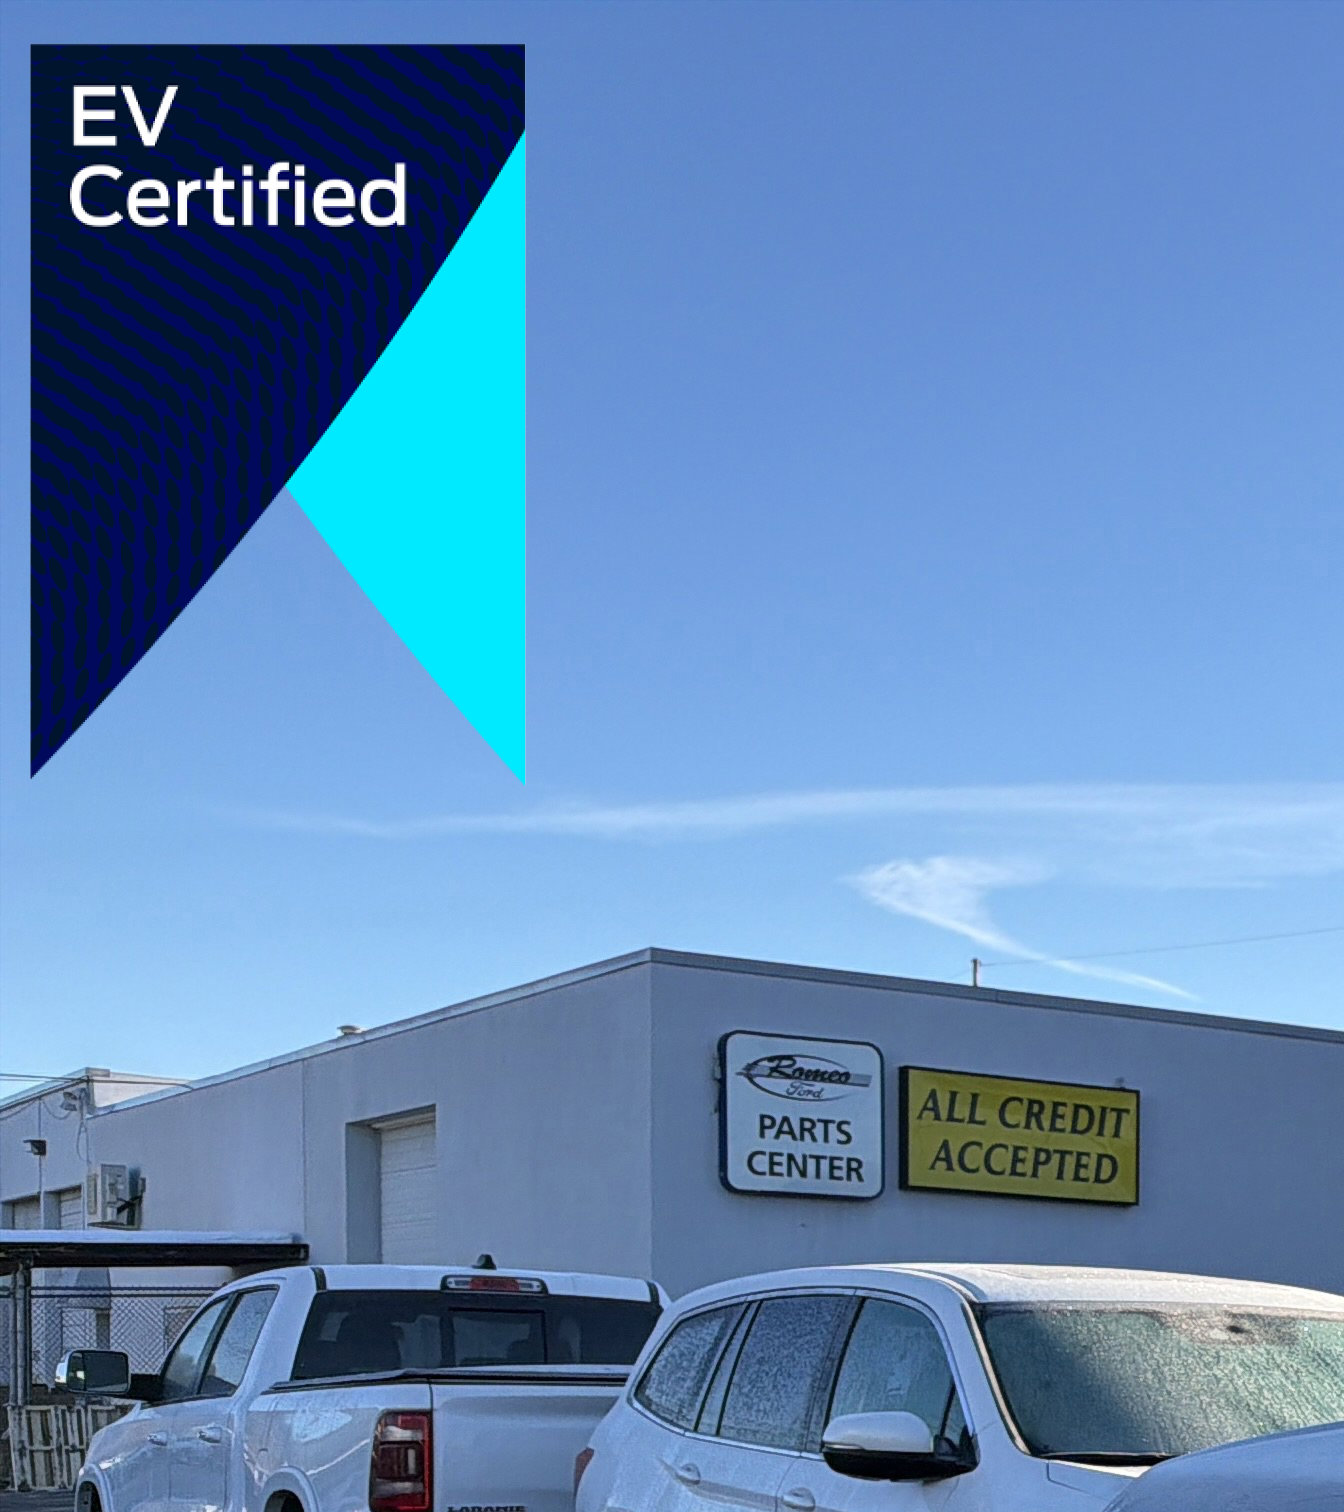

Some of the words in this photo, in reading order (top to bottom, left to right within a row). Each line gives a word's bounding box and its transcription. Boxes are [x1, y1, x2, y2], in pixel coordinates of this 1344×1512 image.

[766, 1056, 851, 1084] Romeo
[785, 1081, 825, 1099] Ford
[758, 1113, 852, 1146] PARTS
[917, 1088, 986, 1126] ALL
[998, 1096, 1131, 1139] CREDIT
[746, 1150, 864, 1183] CENTER
[929, 1139, 1119, 1185] ACCEPTED
